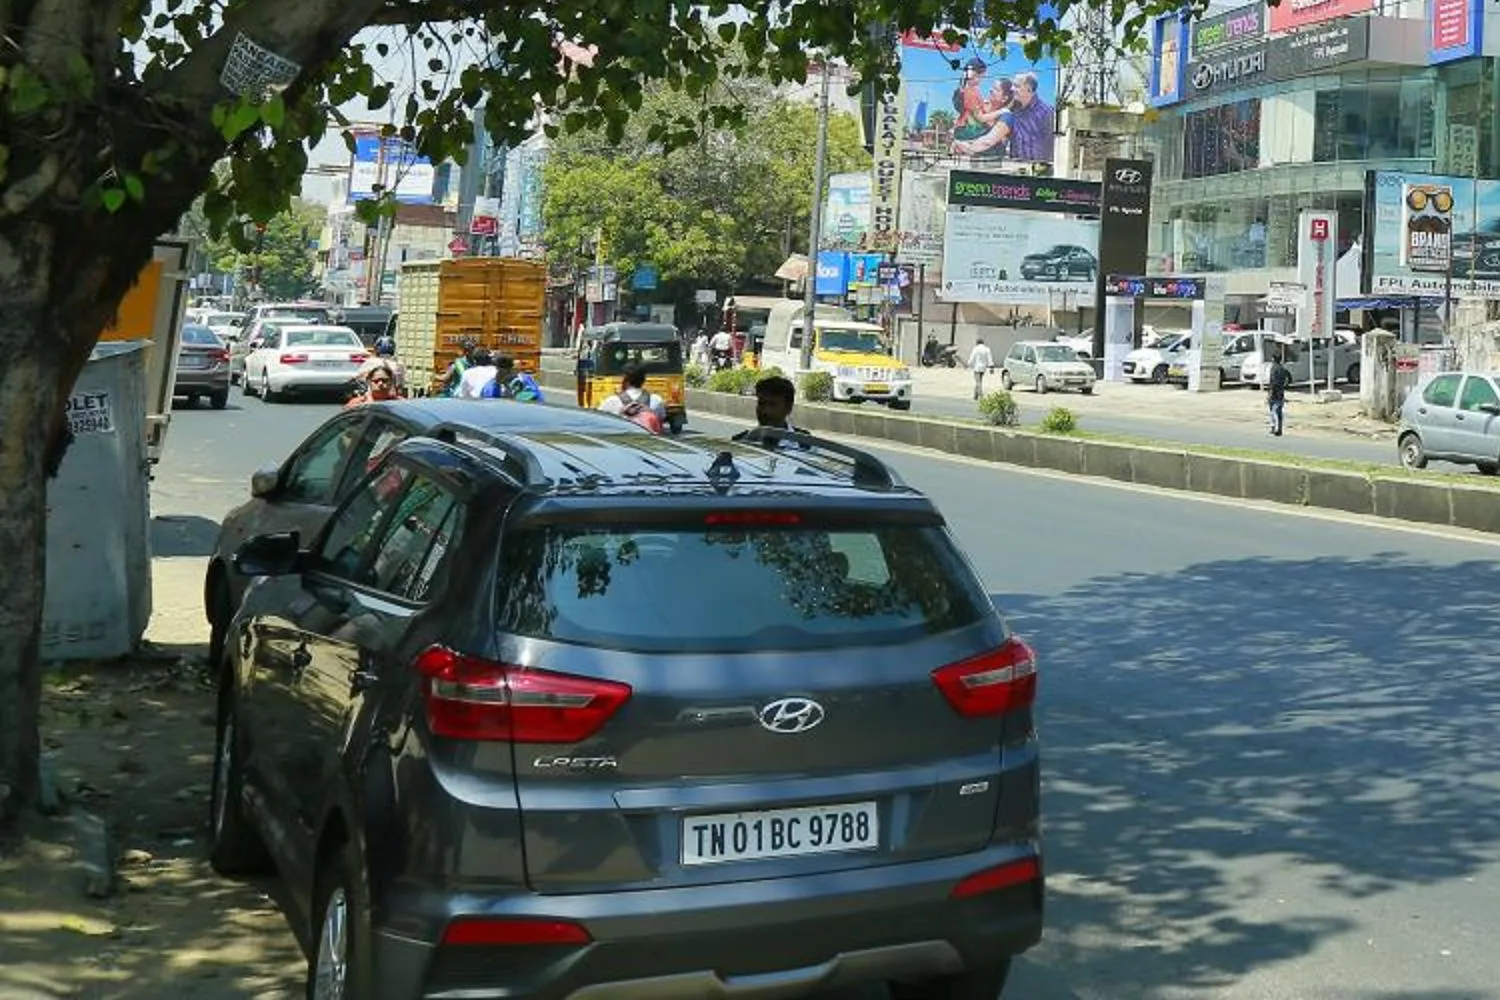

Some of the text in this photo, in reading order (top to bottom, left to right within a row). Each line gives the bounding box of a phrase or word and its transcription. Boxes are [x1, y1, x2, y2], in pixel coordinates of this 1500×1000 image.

[1213, 50, 1265, 84] HYUNDAI
[875, 206, 893, 232] HOU
[809, 811, 869, 847] 9788
